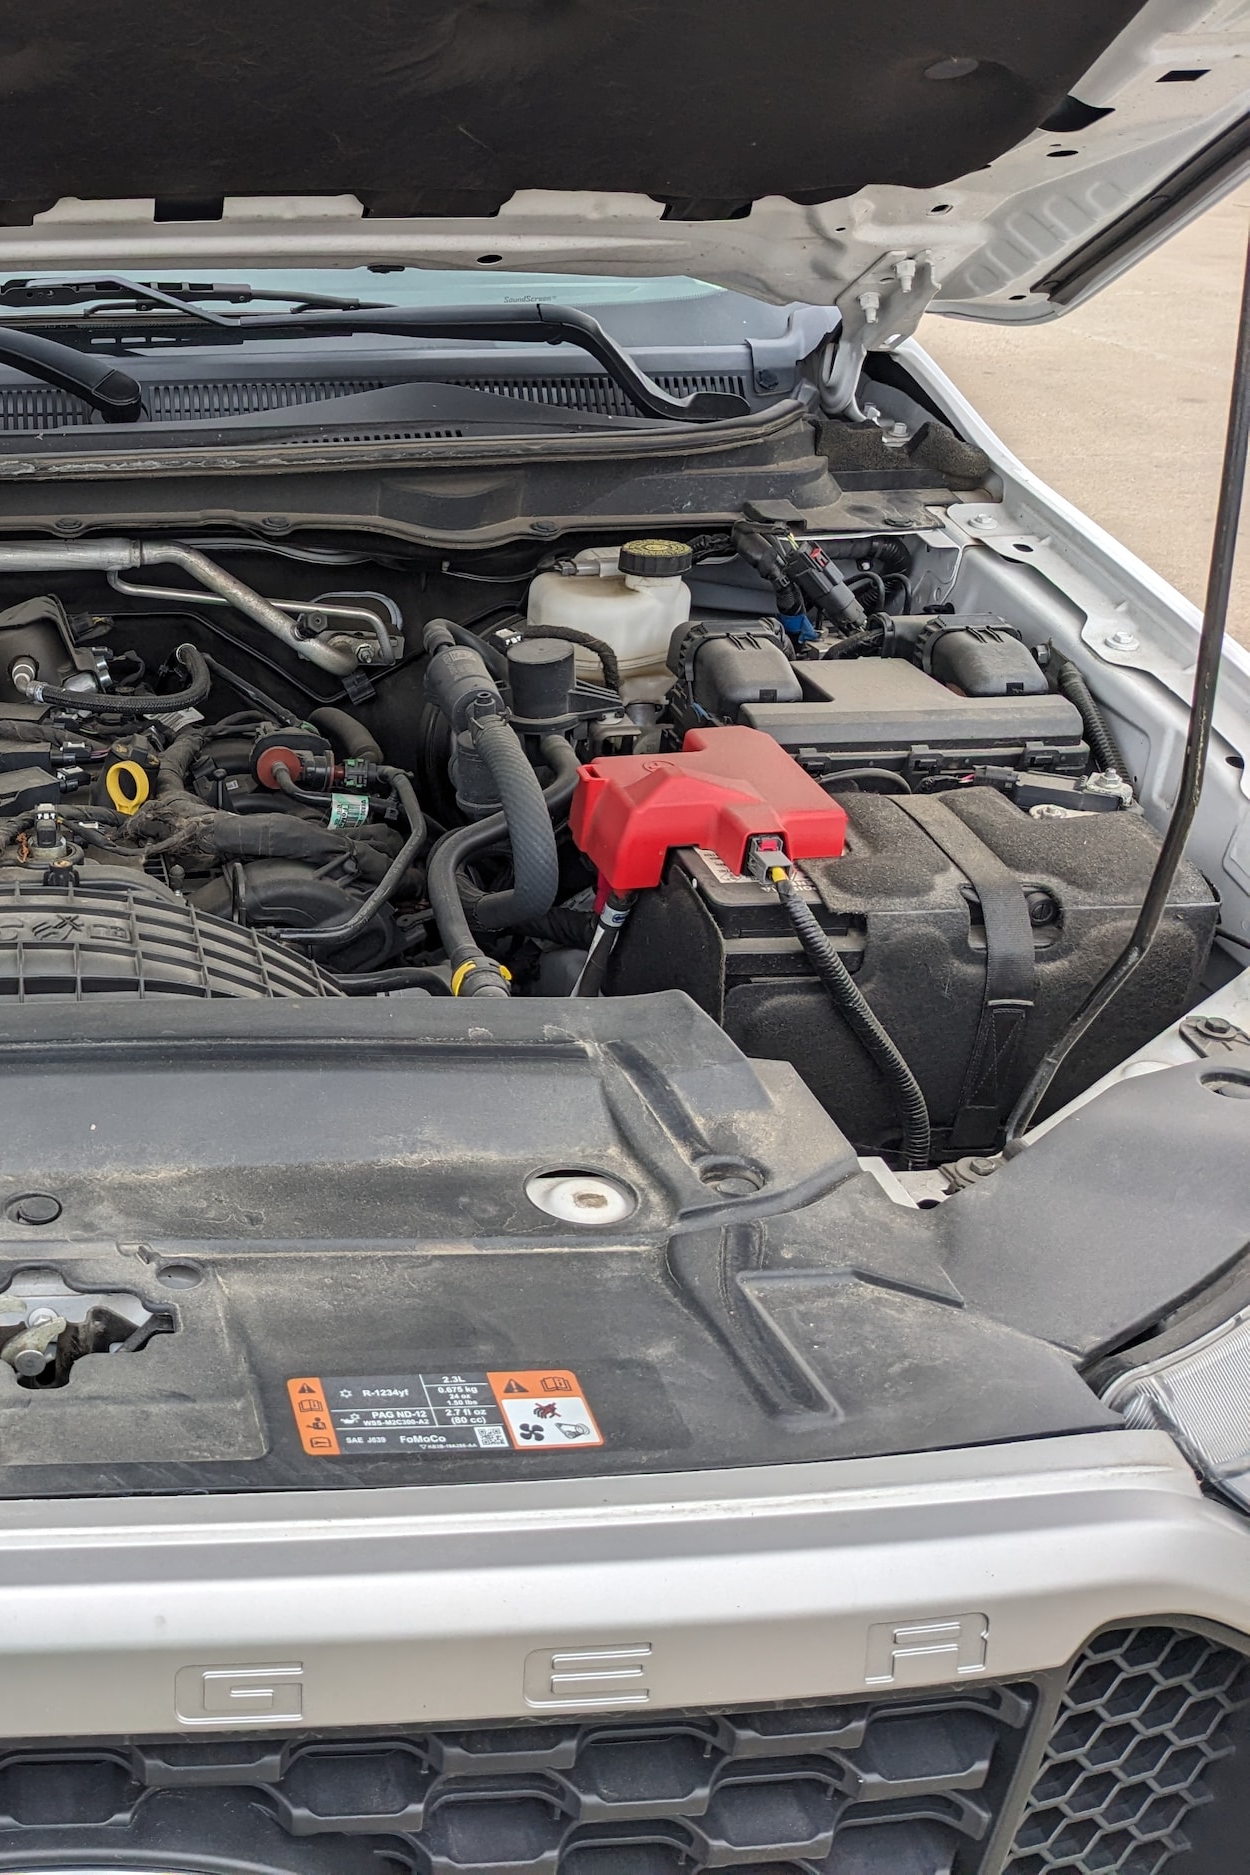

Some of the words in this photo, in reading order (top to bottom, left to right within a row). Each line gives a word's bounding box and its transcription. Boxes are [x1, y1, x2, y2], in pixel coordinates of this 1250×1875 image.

[441, 1375, 467, 1384] 2.3L
[361, 1388, 410, 1398] R-1234yf
[437, 1386, 464, 1394] 0.675
[464, 1386, 478, 1394] kg
[371, 1411, 395, 1419] PAG
[396, 1410, 428, 1418] ND-12
[444, 1408, 461, 1416] 2.7
[462, 1408, 472, 1416] fl
[450, 1416, 468, 1425] (80
[469, 1415, 487, 1425] cc)
[345, 1436, 364, 1444] SAE
[399, 1434, 447, 1444] FoMoCo
